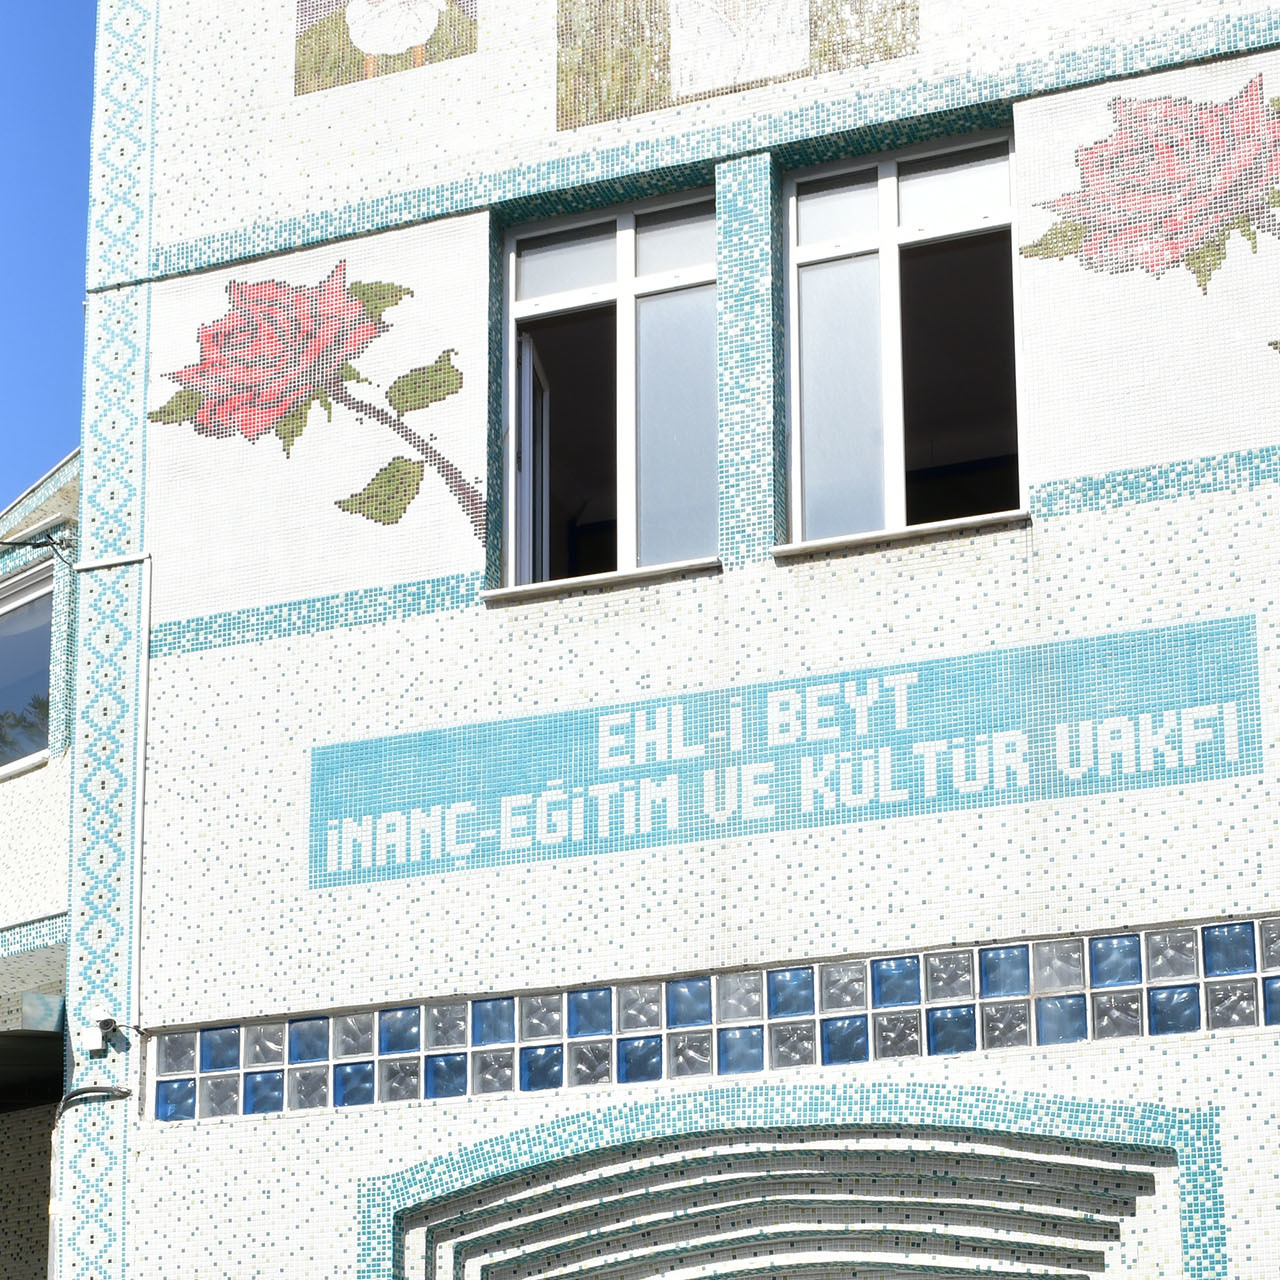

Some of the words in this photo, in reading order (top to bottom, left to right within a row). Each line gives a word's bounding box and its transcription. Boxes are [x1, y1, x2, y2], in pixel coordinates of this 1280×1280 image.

[767, 672, 919, 747] BEYT
[801, 730, 1030, 813] KÜLTÜR
[1055, 701, 1240, 779] VAKFI
